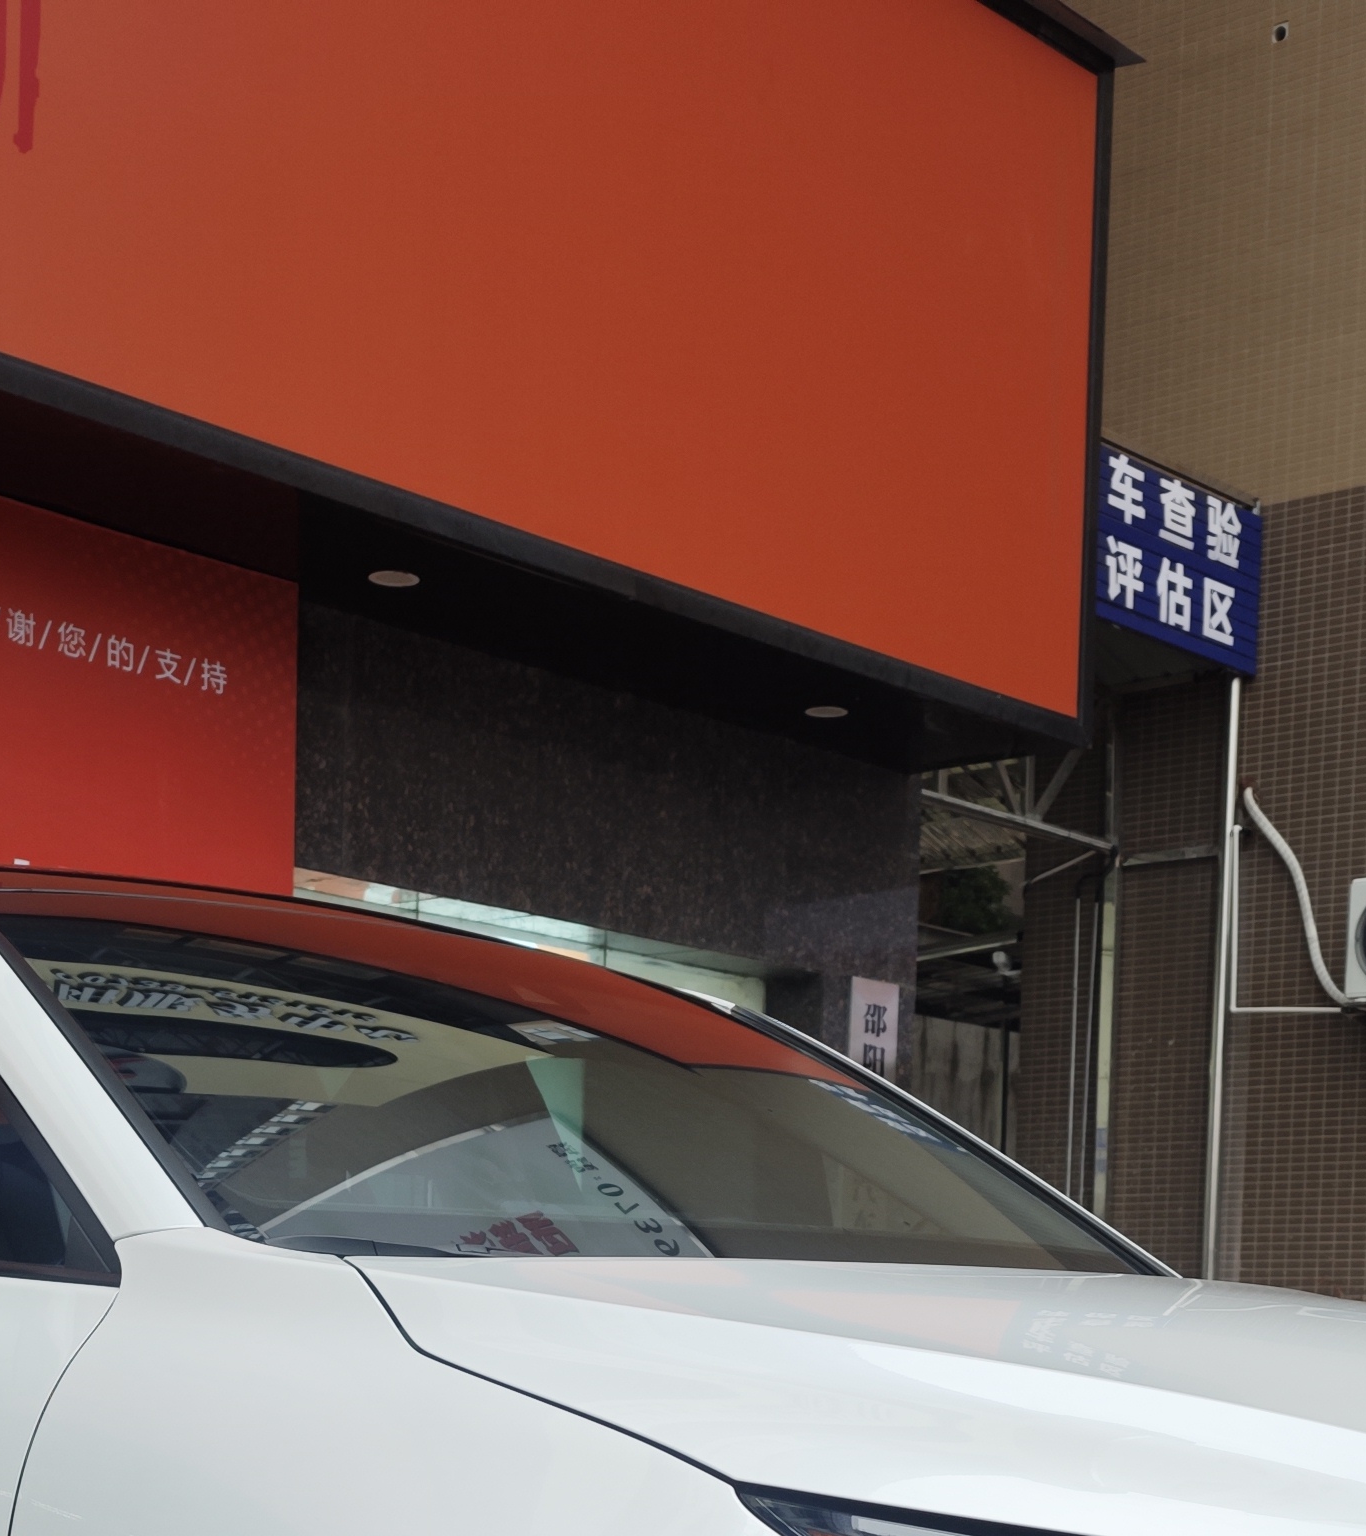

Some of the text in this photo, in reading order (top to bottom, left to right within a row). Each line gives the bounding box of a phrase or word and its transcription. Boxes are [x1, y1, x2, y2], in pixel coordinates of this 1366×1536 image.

[1106, 453, 1243, 569] 车查验
[1105, 534, 1236, 647] 评估区
